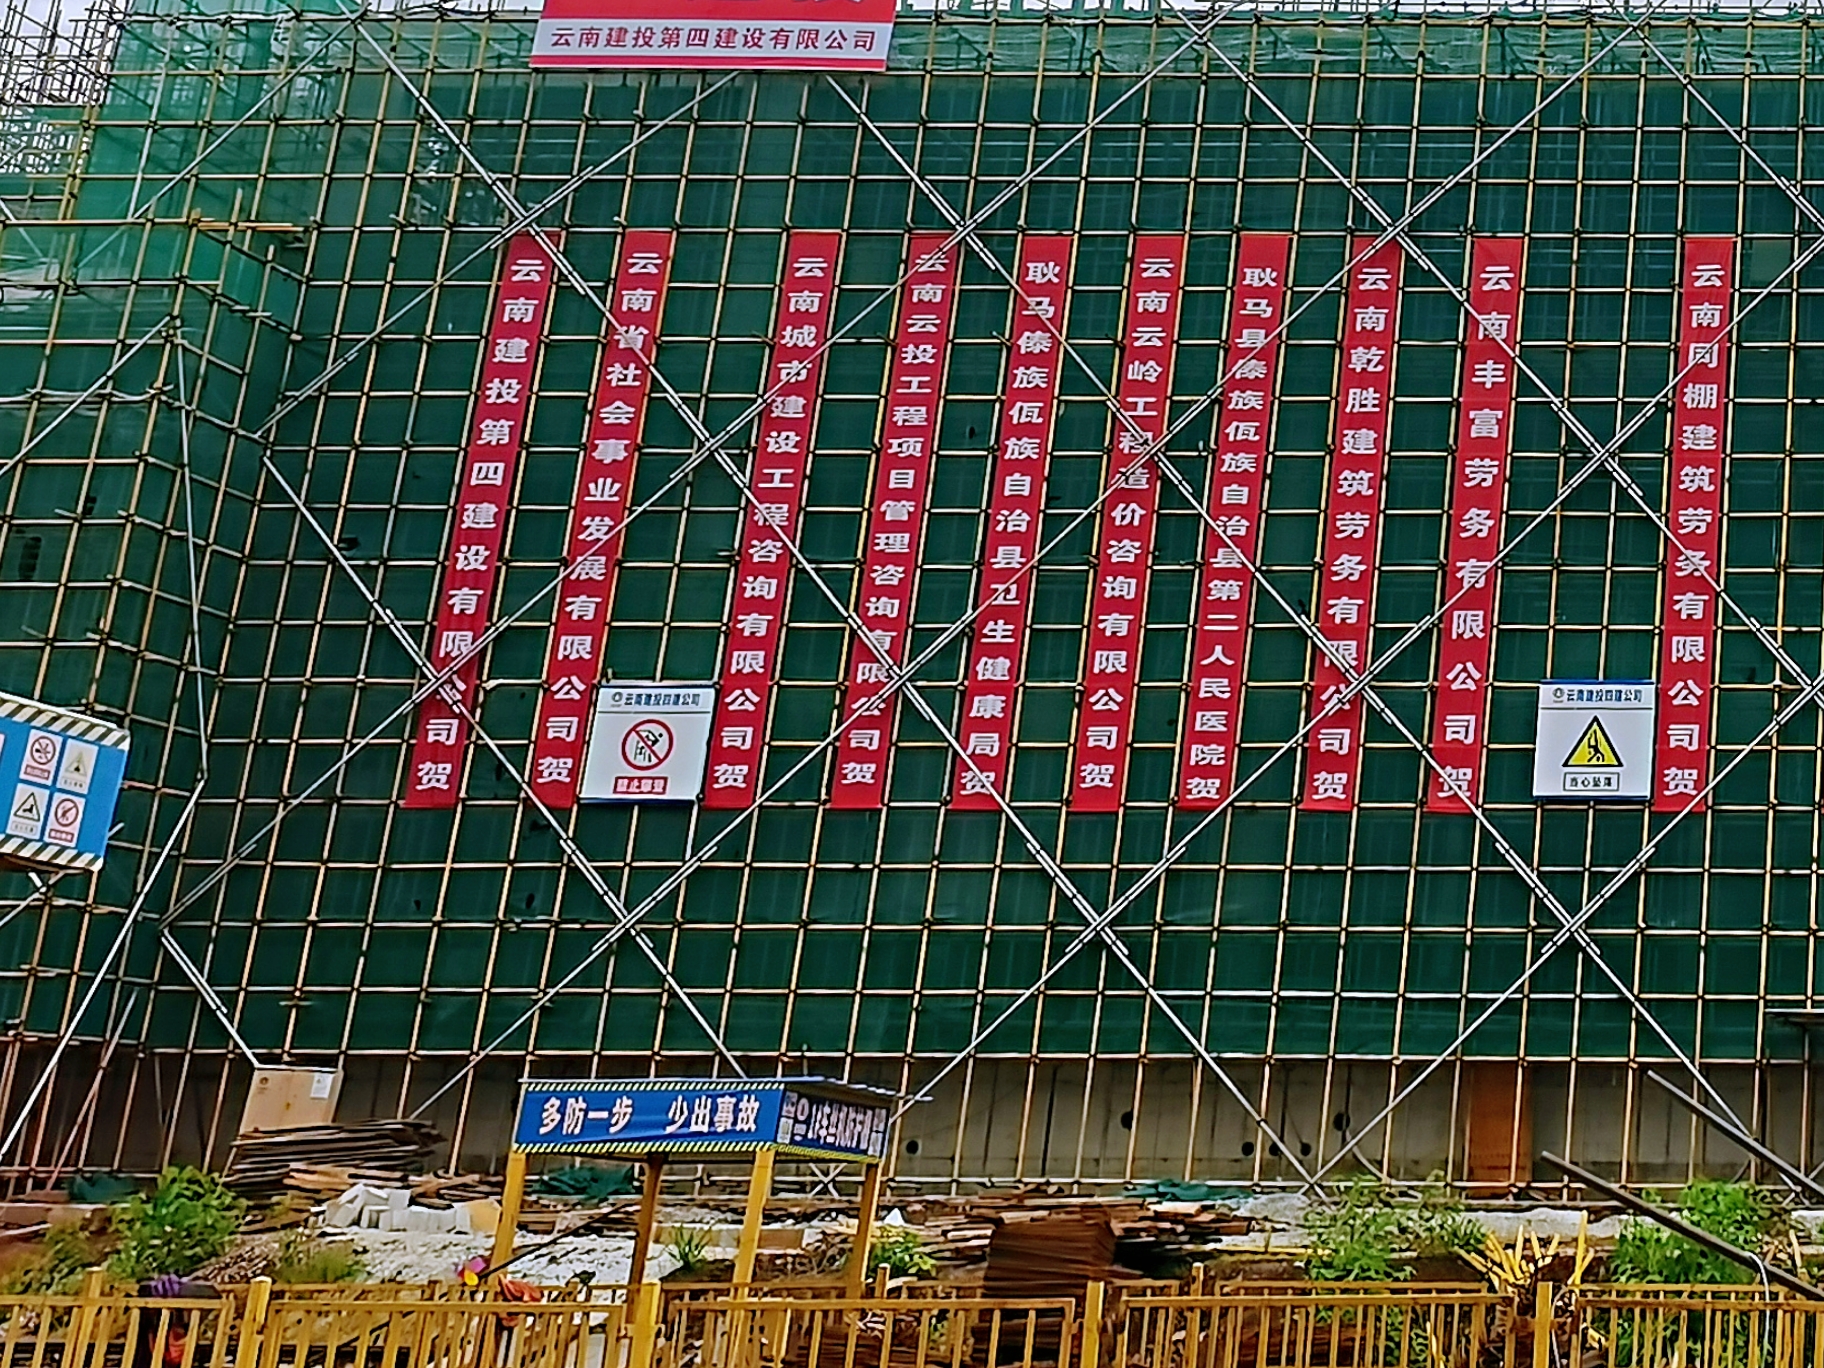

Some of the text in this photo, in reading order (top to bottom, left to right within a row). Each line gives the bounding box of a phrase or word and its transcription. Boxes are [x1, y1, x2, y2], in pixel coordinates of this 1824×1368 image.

[550, 25, 877, 53] 云南建投第四建设有限公司
[537, 252, 664, 783] 云南省社会事业发展有限公司贺
[713, 256, 828, 789] 云南城市建设工程咨询有限公司贺
[839, 252, 950, 783] 云南云投工程项目管理咨询有限公司贺
[960, 260, 1061, 794] 耿马傣族佤族自治县卫生健康局贺
[1079, 258, 1175, 787] 云南云岭工程造价咨询有限公司贺
[1186, 266, 1279, 799] 耿马县傣族佤族自治县第二人民医院贺
[1311, 267, 1393, 800] 云南乾胜建筑劳务有限公司贺
[1437, 265, 1516, 799] 云南丰富劳务有限公司贺
[539, 1094, 761, 1135] 多防一步 少出事故
